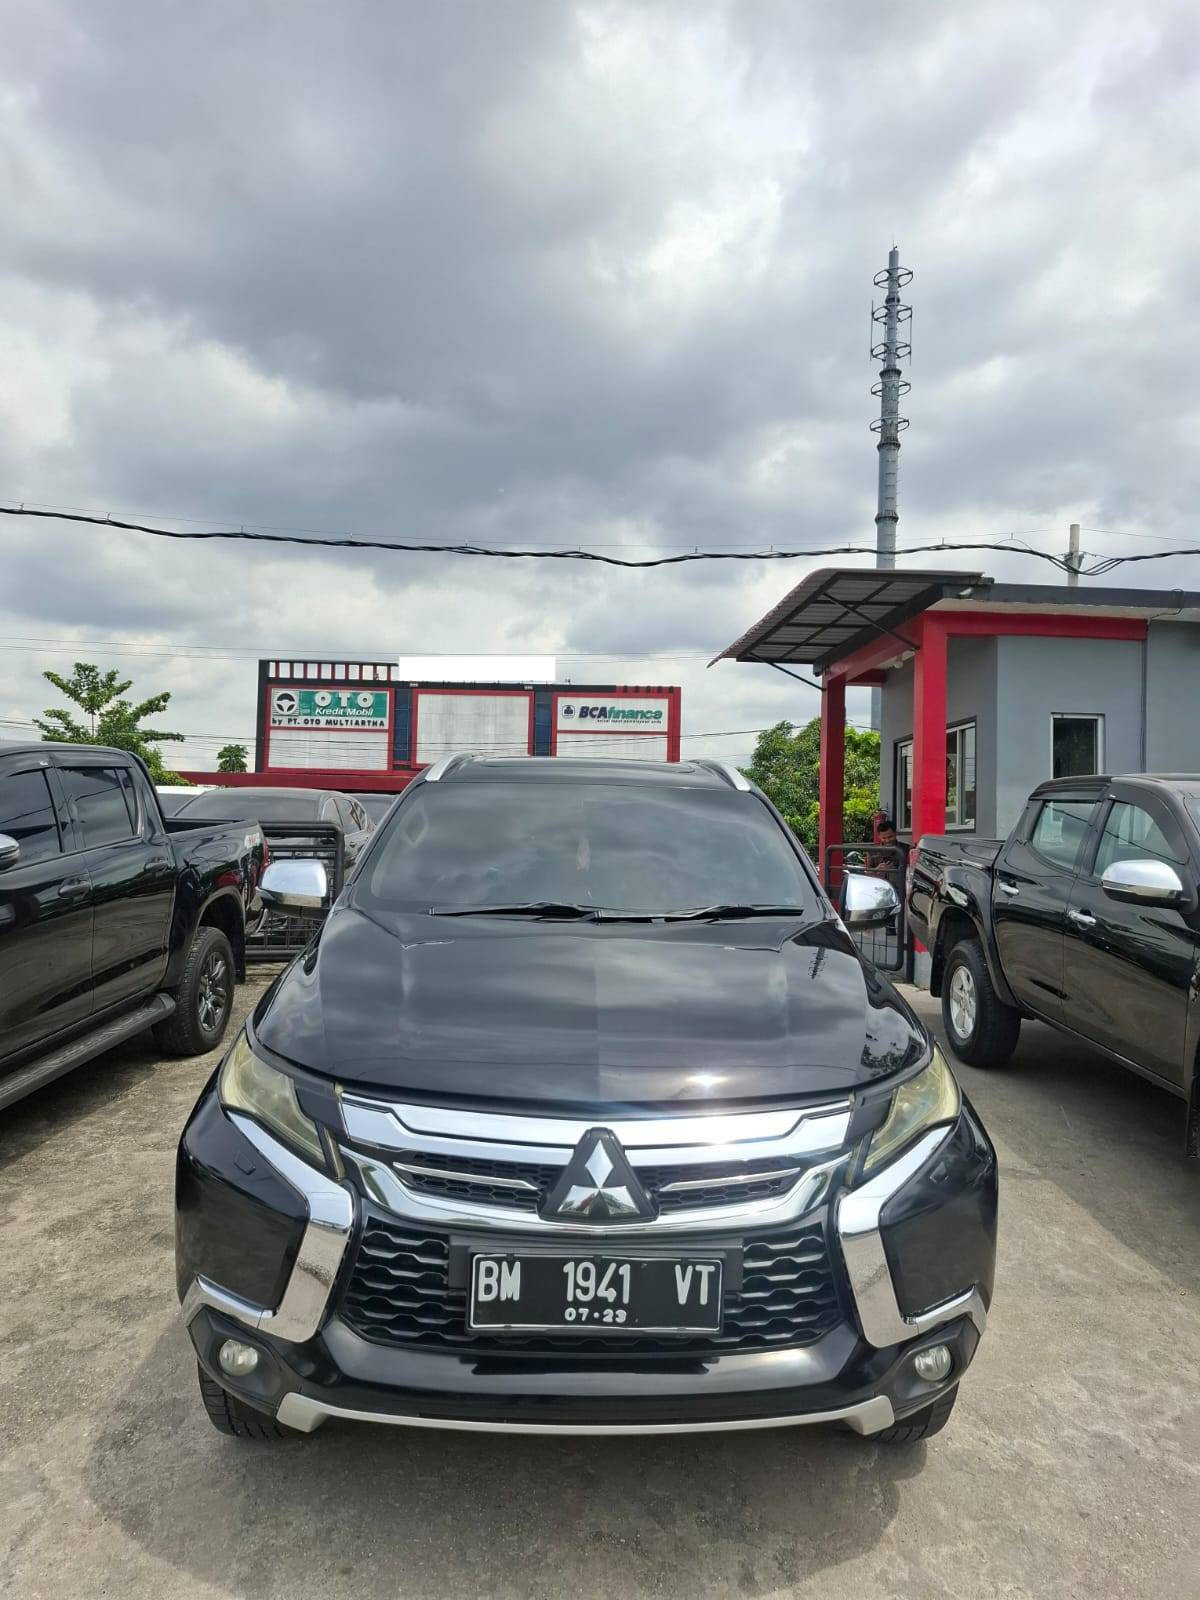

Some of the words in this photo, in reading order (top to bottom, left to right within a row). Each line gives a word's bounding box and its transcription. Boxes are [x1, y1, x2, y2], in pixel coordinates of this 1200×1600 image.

[315, 691, 374, 708] OTO
[315, 707, 344, 716] Kredit
[346, 708, 374, 717] Mobil
[477, 1260, 521, 1301] BM
[563, 1261, 631, 1304] 1941
[674, 1264, 716, 1305] VT
